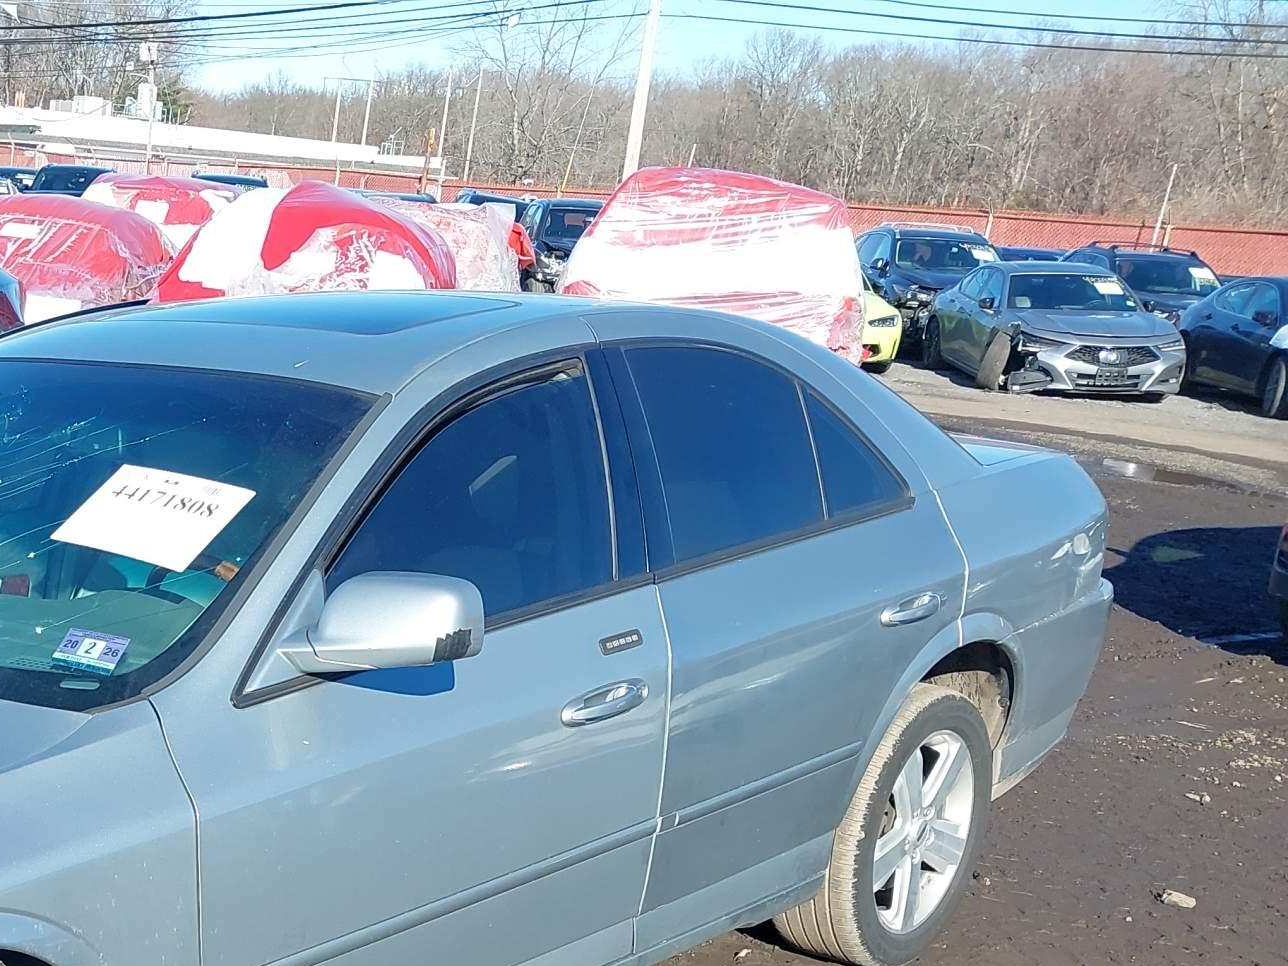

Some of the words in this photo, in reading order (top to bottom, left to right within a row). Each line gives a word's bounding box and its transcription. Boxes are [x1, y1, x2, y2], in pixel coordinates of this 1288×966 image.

[112, 484, 220, 518] 44171808
[63, 639, 80, 649] 20
[84, 641, 97, 655] 2
[103, 647, 121, 658] 26
